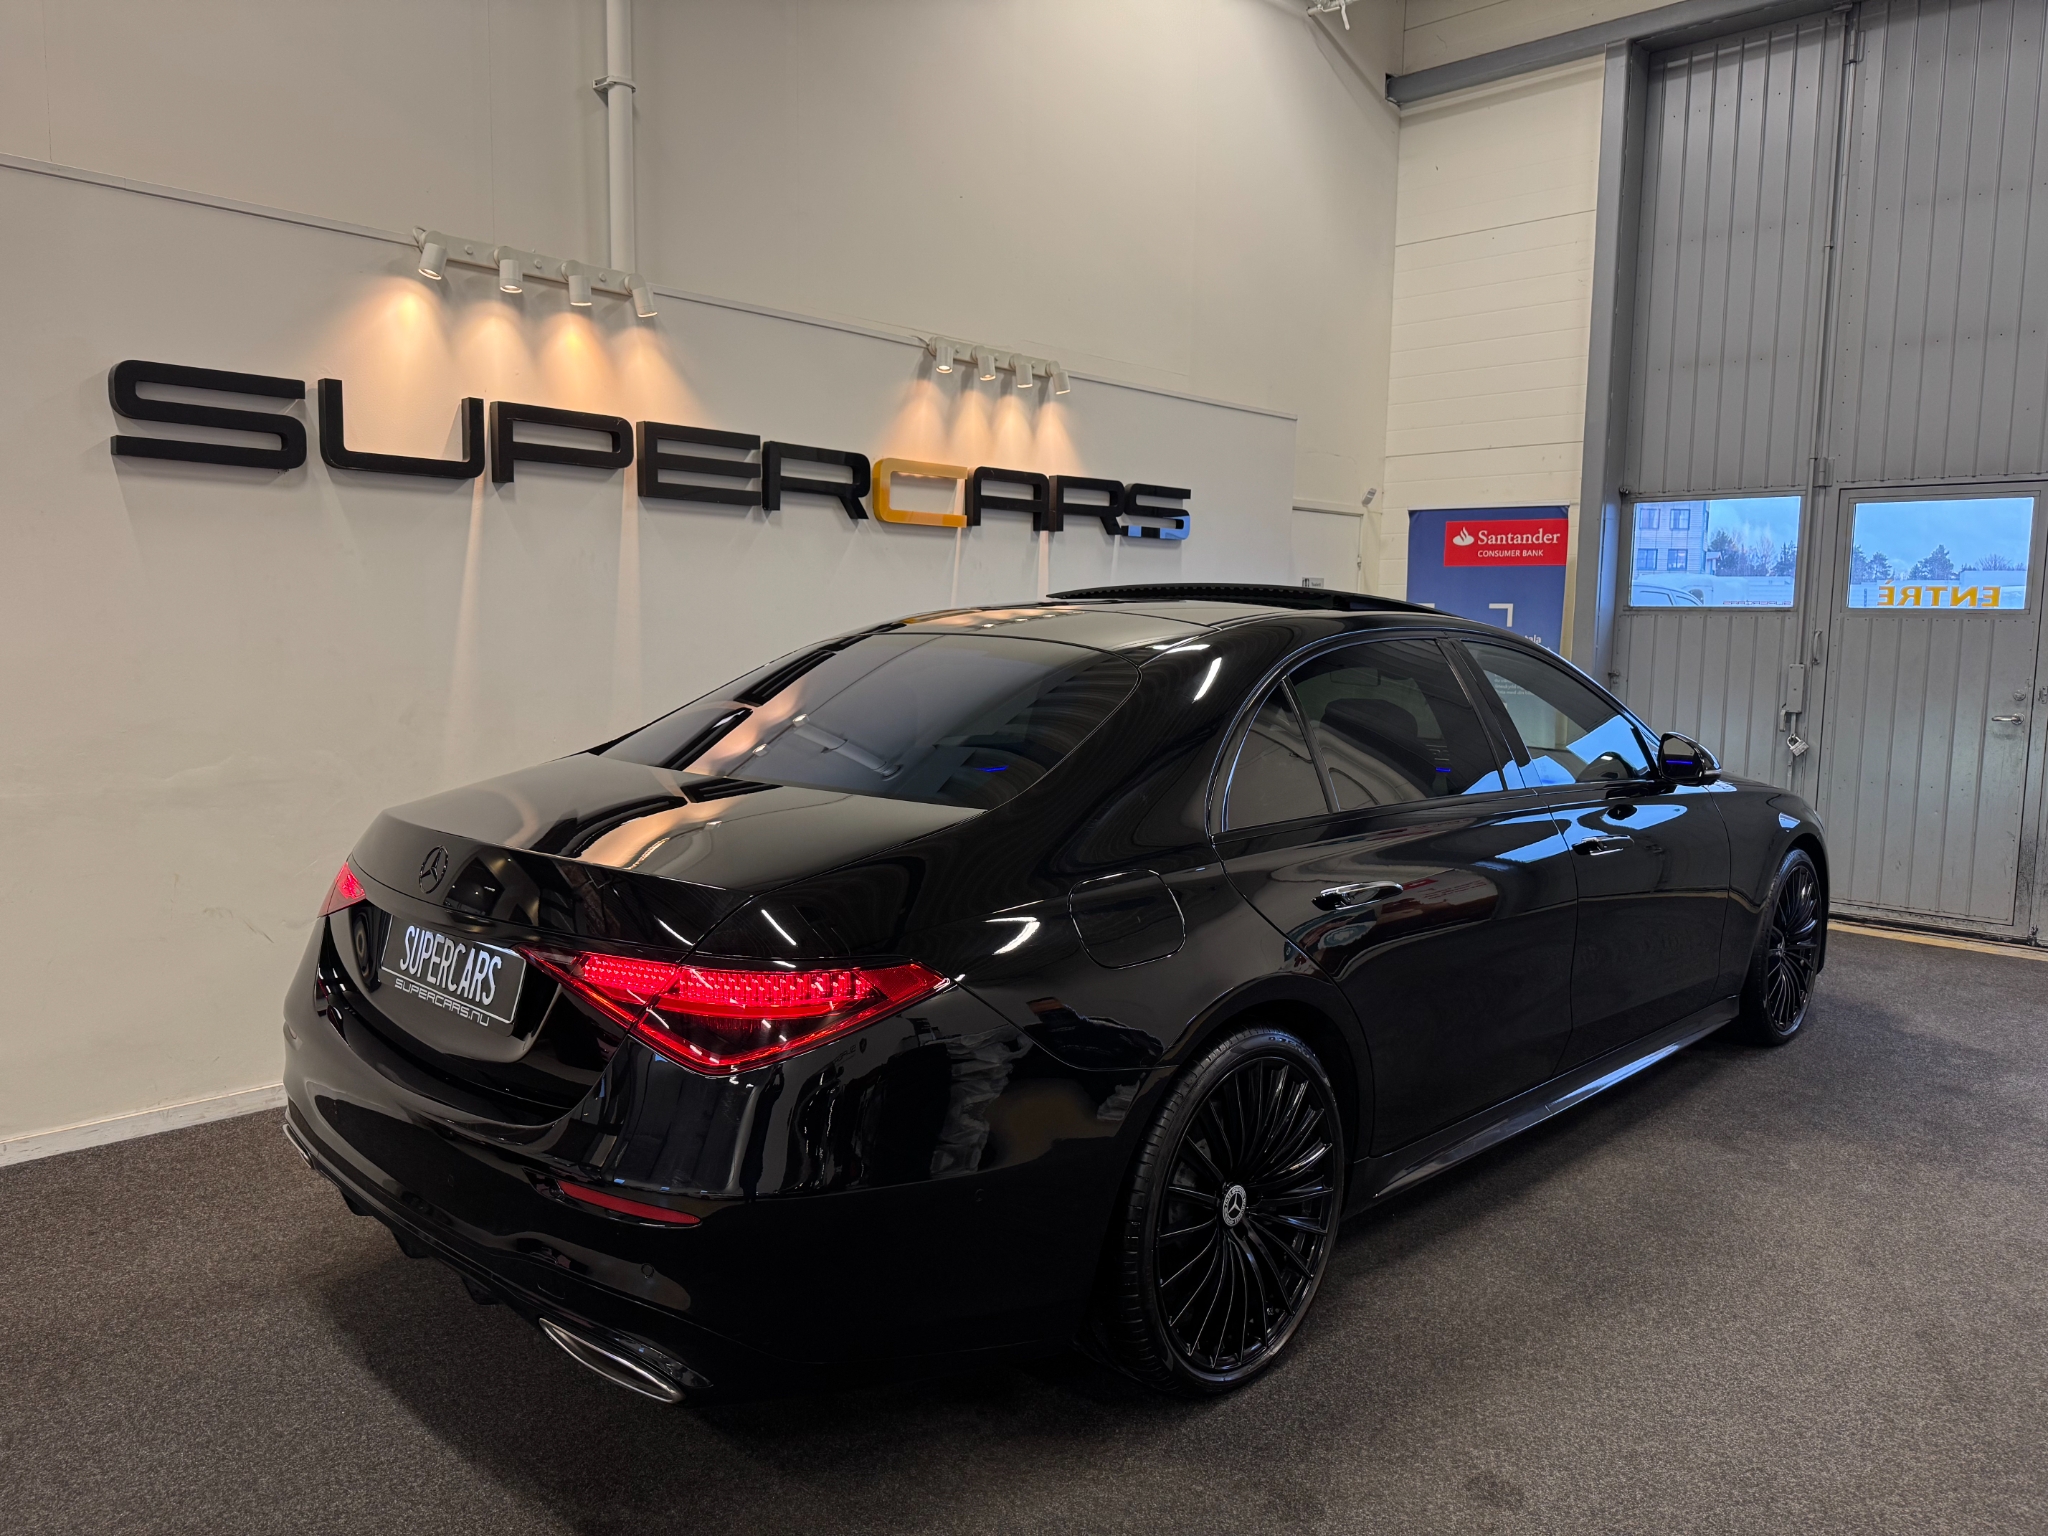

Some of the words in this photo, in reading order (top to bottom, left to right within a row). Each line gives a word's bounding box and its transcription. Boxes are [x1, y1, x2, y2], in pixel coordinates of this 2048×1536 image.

[108, 360, 1191, 540] SUPERCARS
[1477, 528, 1561, 545] Santander
[1477, 549, 1521, 558] CONSUMER
[1522, 549, 1544, 557] BANK
[400, 925, 502, 1006] SUPERCARS
[394, 978, 491, 1027] SUPERCARS.NU
